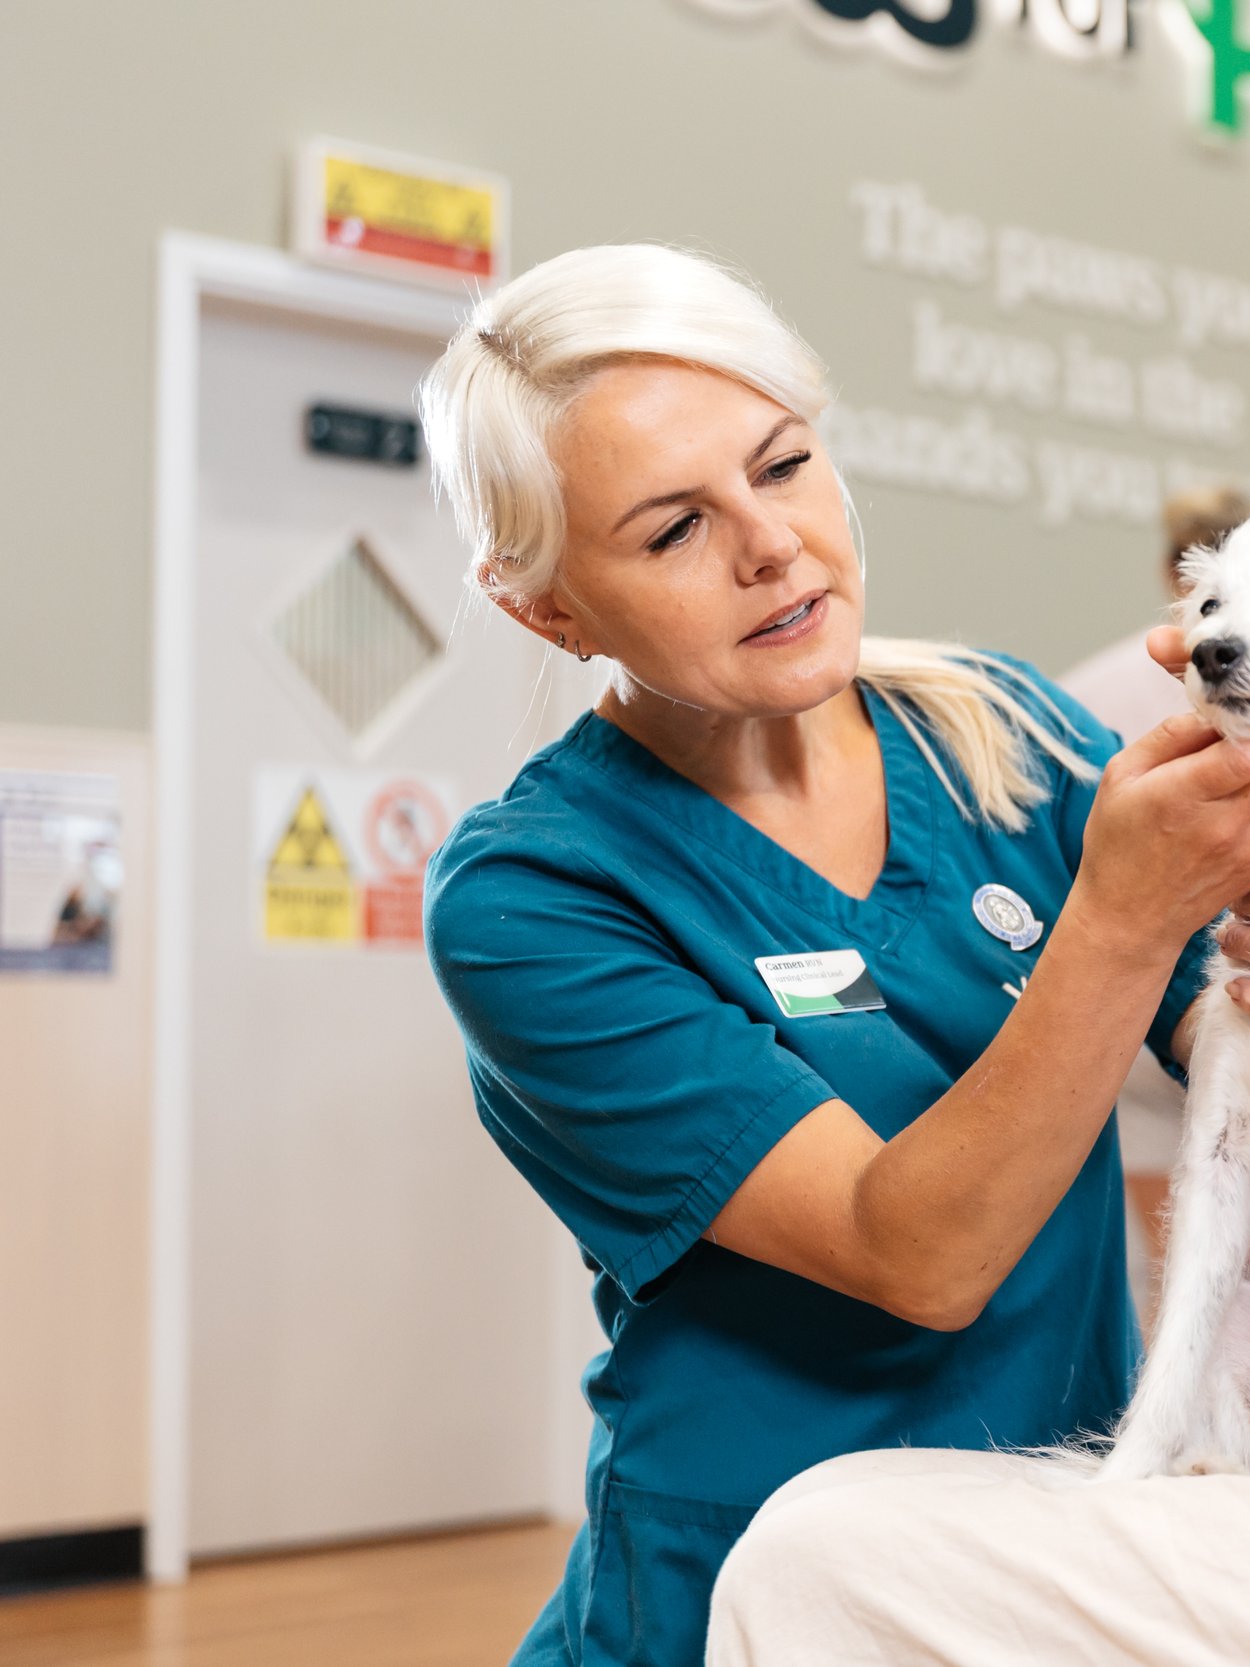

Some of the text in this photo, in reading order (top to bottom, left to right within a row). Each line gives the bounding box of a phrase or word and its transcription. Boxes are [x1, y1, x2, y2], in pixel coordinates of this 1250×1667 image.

[850, 180, 986, 282] The
[913, 298, 1058, 410] love
[765, 960, 805, 971] Carmen
